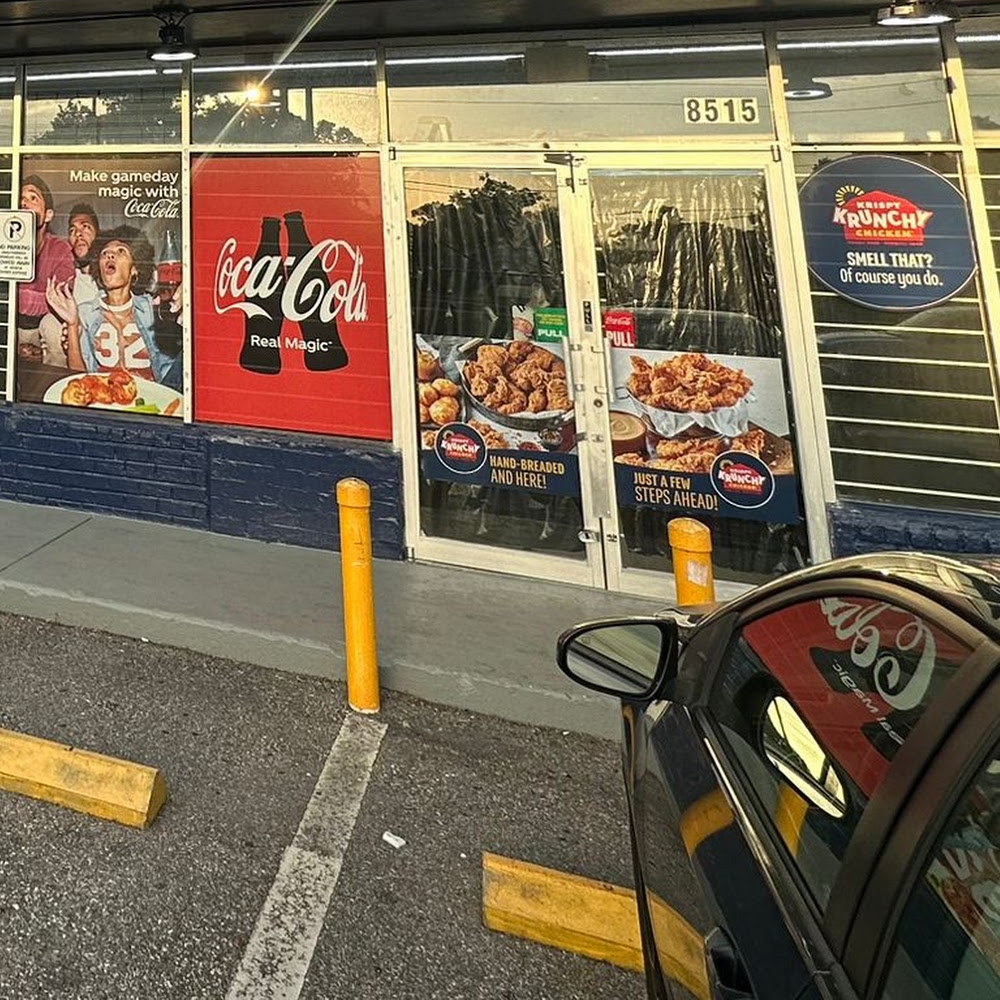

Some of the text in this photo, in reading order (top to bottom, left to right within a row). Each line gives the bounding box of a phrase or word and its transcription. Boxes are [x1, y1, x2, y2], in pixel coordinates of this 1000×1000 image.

[686, 99, 756, 122] 8515
[69, 169, 179, 185] Make gameday
[98, 184, 179, 200] magic with
[124, 198, 181, 218] Coca-Cola
[856, 201, 901, 209] KRISPY
[833, 206, 934, 229] KRUNCHY
[855, 229, 913, 238] CHICKEN
[846, 251, 934, 268] SMELL THAT?
[214, 238, 369, 323] Coca-Cola
[840, 267, 944, 289] Of course you do.
[537, 328, 563, 338] PULL
[605, 330, 635, 347] PULL
[94, 322, 151, 369] 32
[250, 335, 330, 353] Real Magic
[489, 455, 565, 474] HAND-BREADED
[491, 469, 547, 489] AND HERE!
[633, 471, 691, 491] JUST A FEW
[635, 486, 719, 511] STEPS AHEAD!
